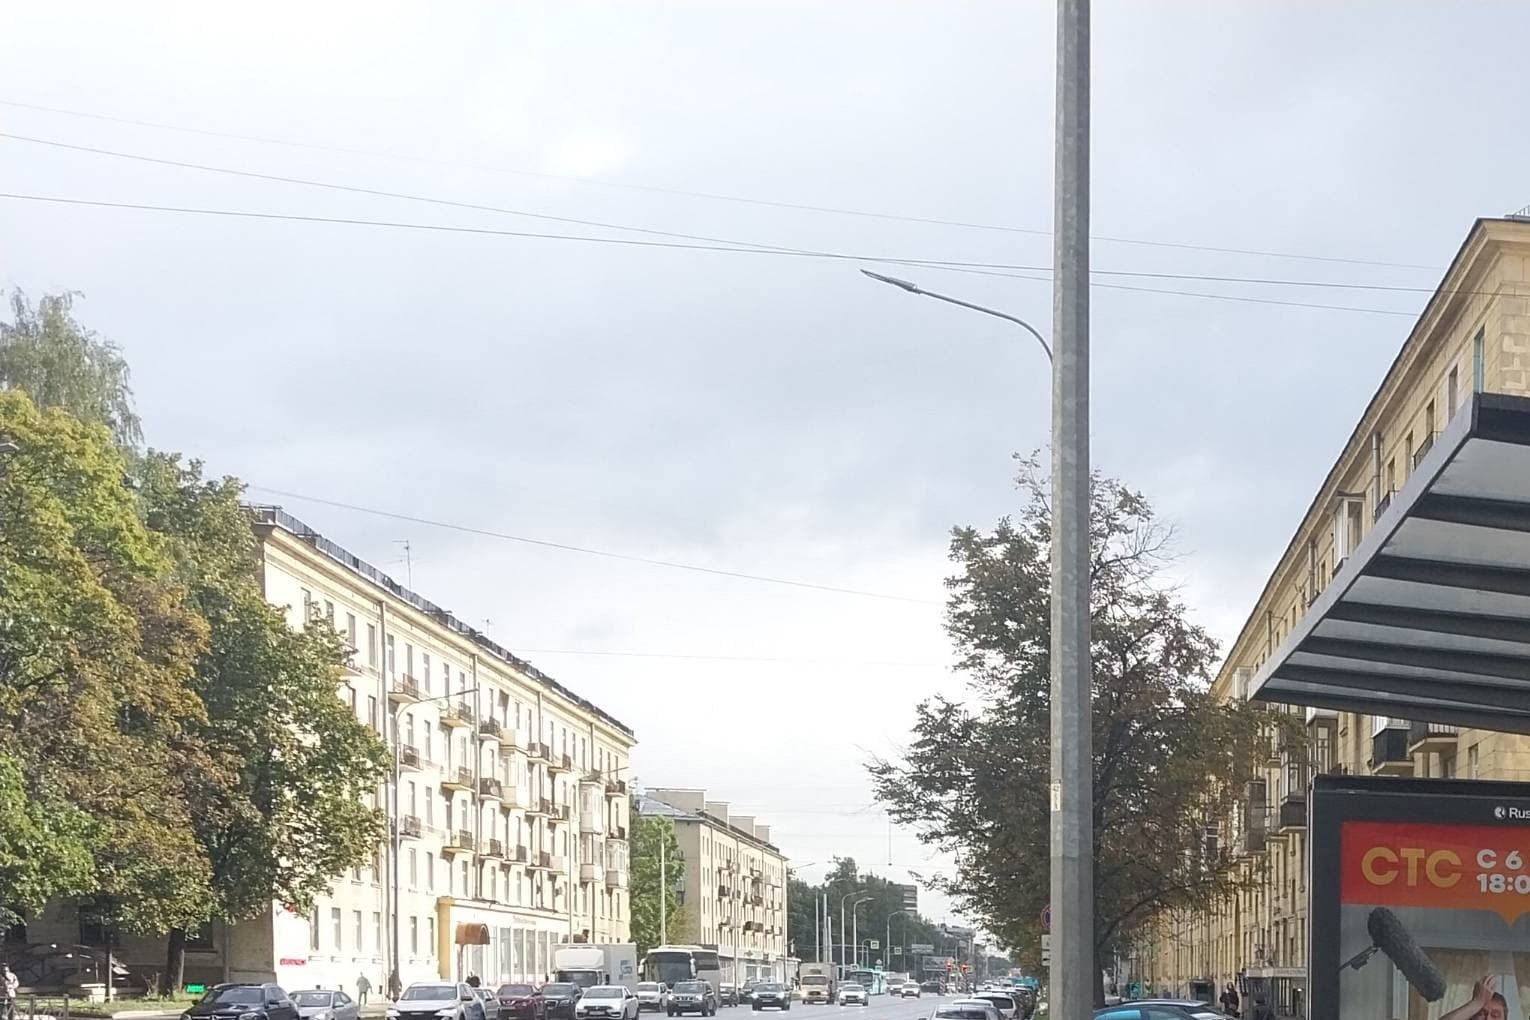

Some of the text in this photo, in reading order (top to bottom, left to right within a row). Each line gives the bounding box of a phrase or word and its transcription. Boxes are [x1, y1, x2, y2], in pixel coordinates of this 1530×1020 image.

[1361, 847, 1463, 888] СТС
[1476, 849, 1497, 869] С
[1505, 850, 1523, 870] 6
